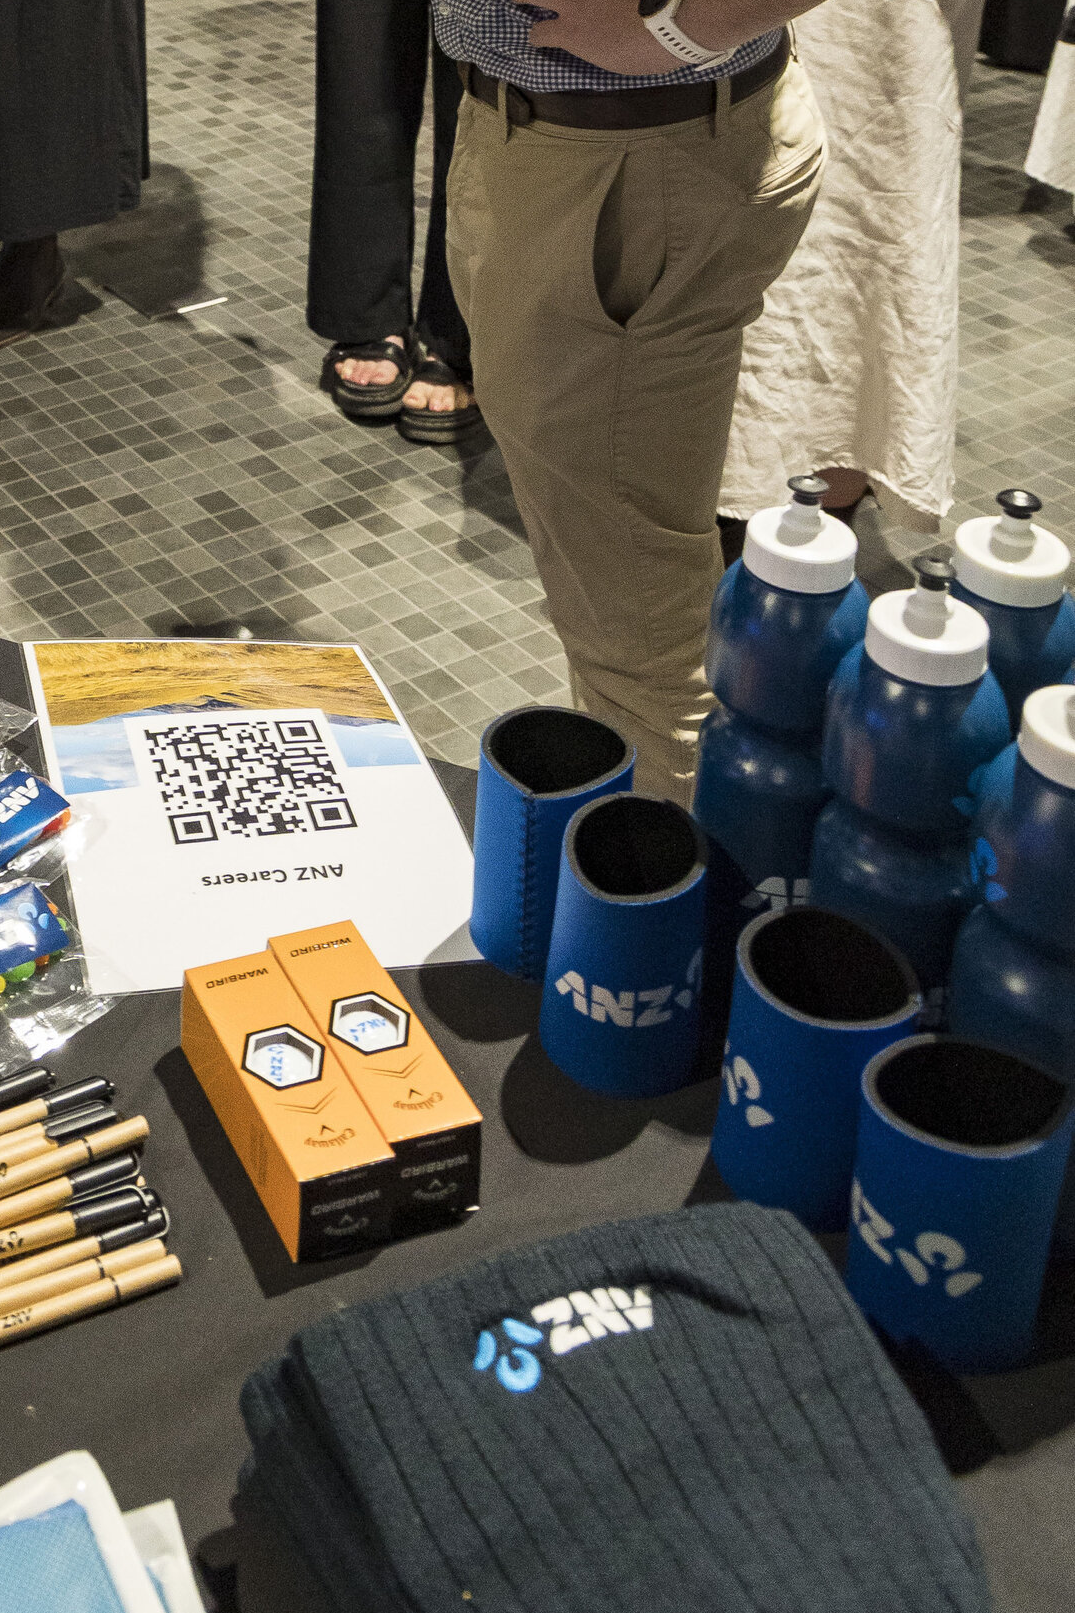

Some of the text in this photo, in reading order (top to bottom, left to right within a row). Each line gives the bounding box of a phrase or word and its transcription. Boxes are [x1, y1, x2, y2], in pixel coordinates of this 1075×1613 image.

[202, 863, 344, 886] ANZ Careers
[290, 937, 352, 958] WARBIRD
[206, 967, 269, 989] WARBIRD
[555, 970, 673, 1028] ANZ
[393, 1091, 444, 1111] Callaway
[304, 1128, 356, 1148] Callaway
[531, 1286, 654, 1355] ANZ
